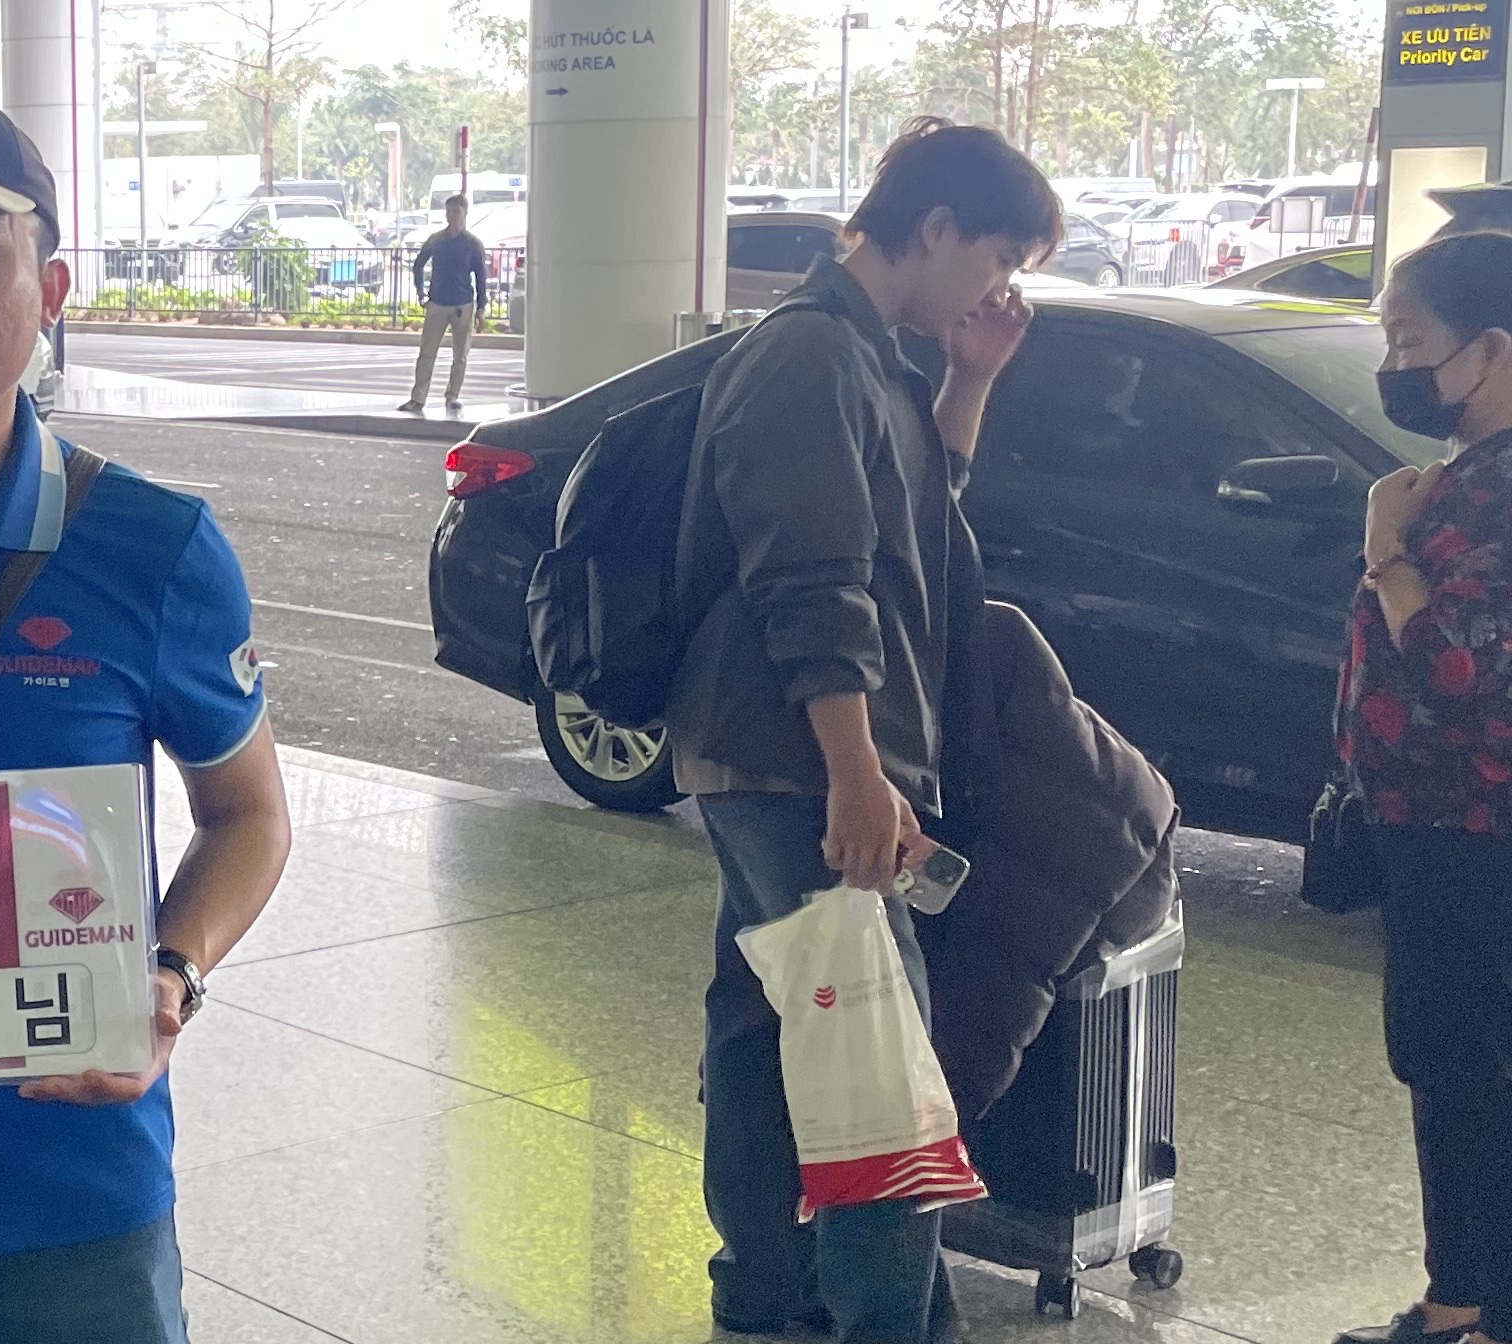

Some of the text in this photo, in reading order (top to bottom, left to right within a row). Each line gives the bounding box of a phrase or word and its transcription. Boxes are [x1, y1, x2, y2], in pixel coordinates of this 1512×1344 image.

[570, 24, 628, 47] THUỐC
[632, 26, 655, 44] LÁ
[1400, 30, 1423, 45] XE
[1453, 23, 1492, 42] TIÊN
[571, 56, 616, 71] AREA
[1400, 46, 1490, 66] Priority Car
[25, 924, 135, 949] GUIDEMAN
[15, 971, 72, 1048] 님
